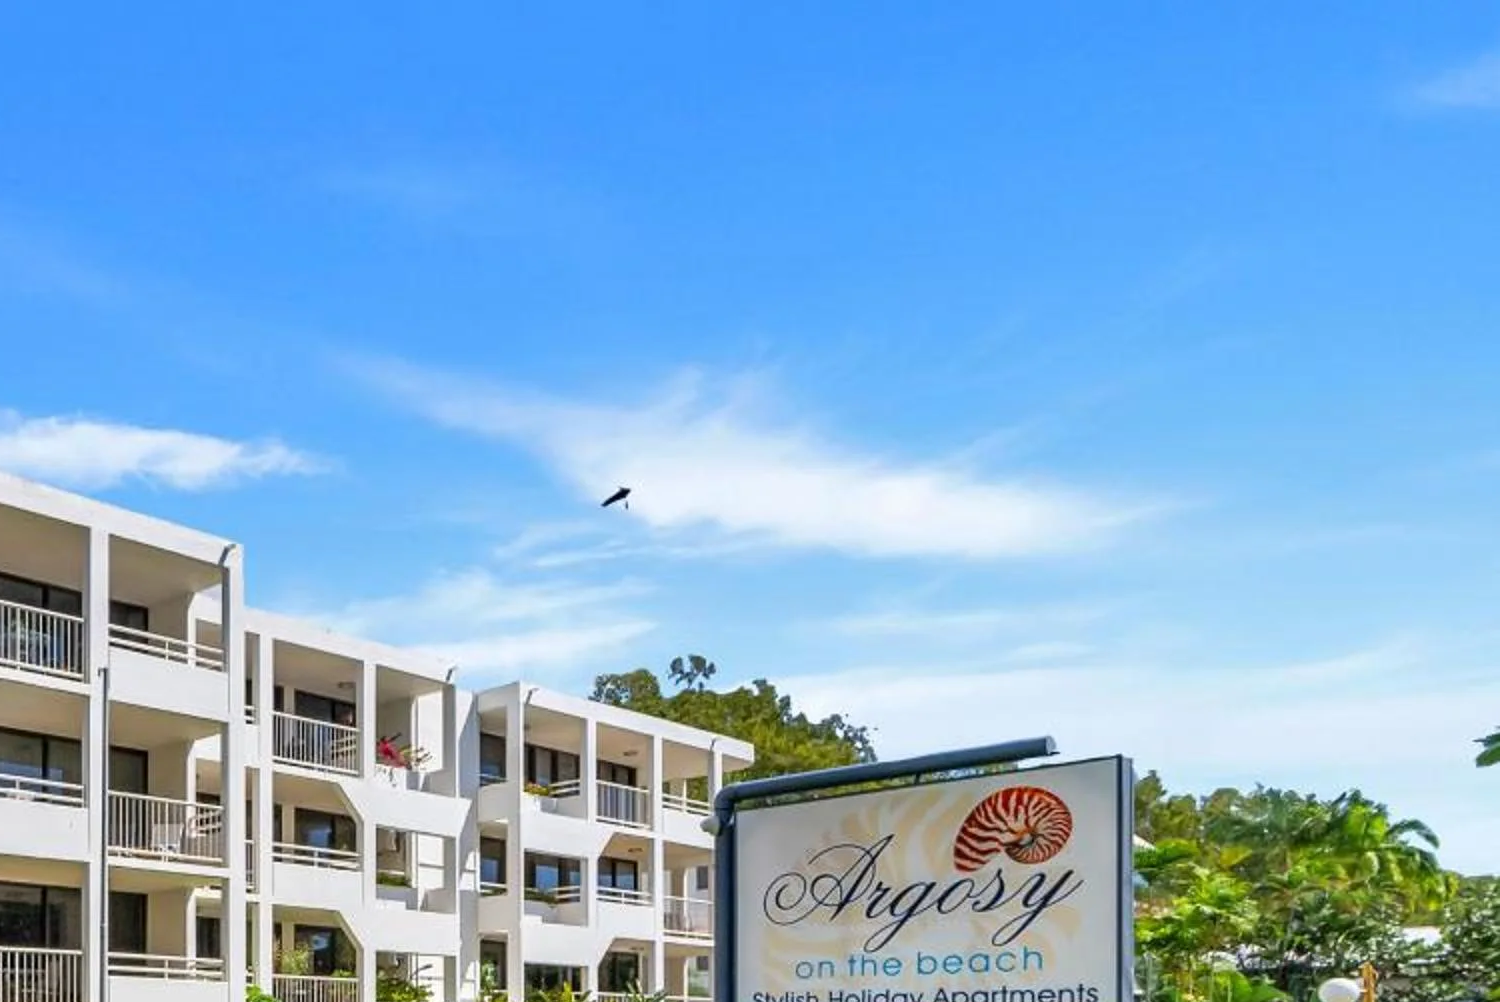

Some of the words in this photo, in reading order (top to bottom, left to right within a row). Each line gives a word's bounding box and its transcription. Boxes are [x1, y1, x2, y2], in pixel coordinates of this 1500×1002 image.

[763, 833, 1084, 953] Argosy
[795, 958, 836, 980] on
[848, 952, 902, 977] the
[917, 946, 1043, 976] beach
